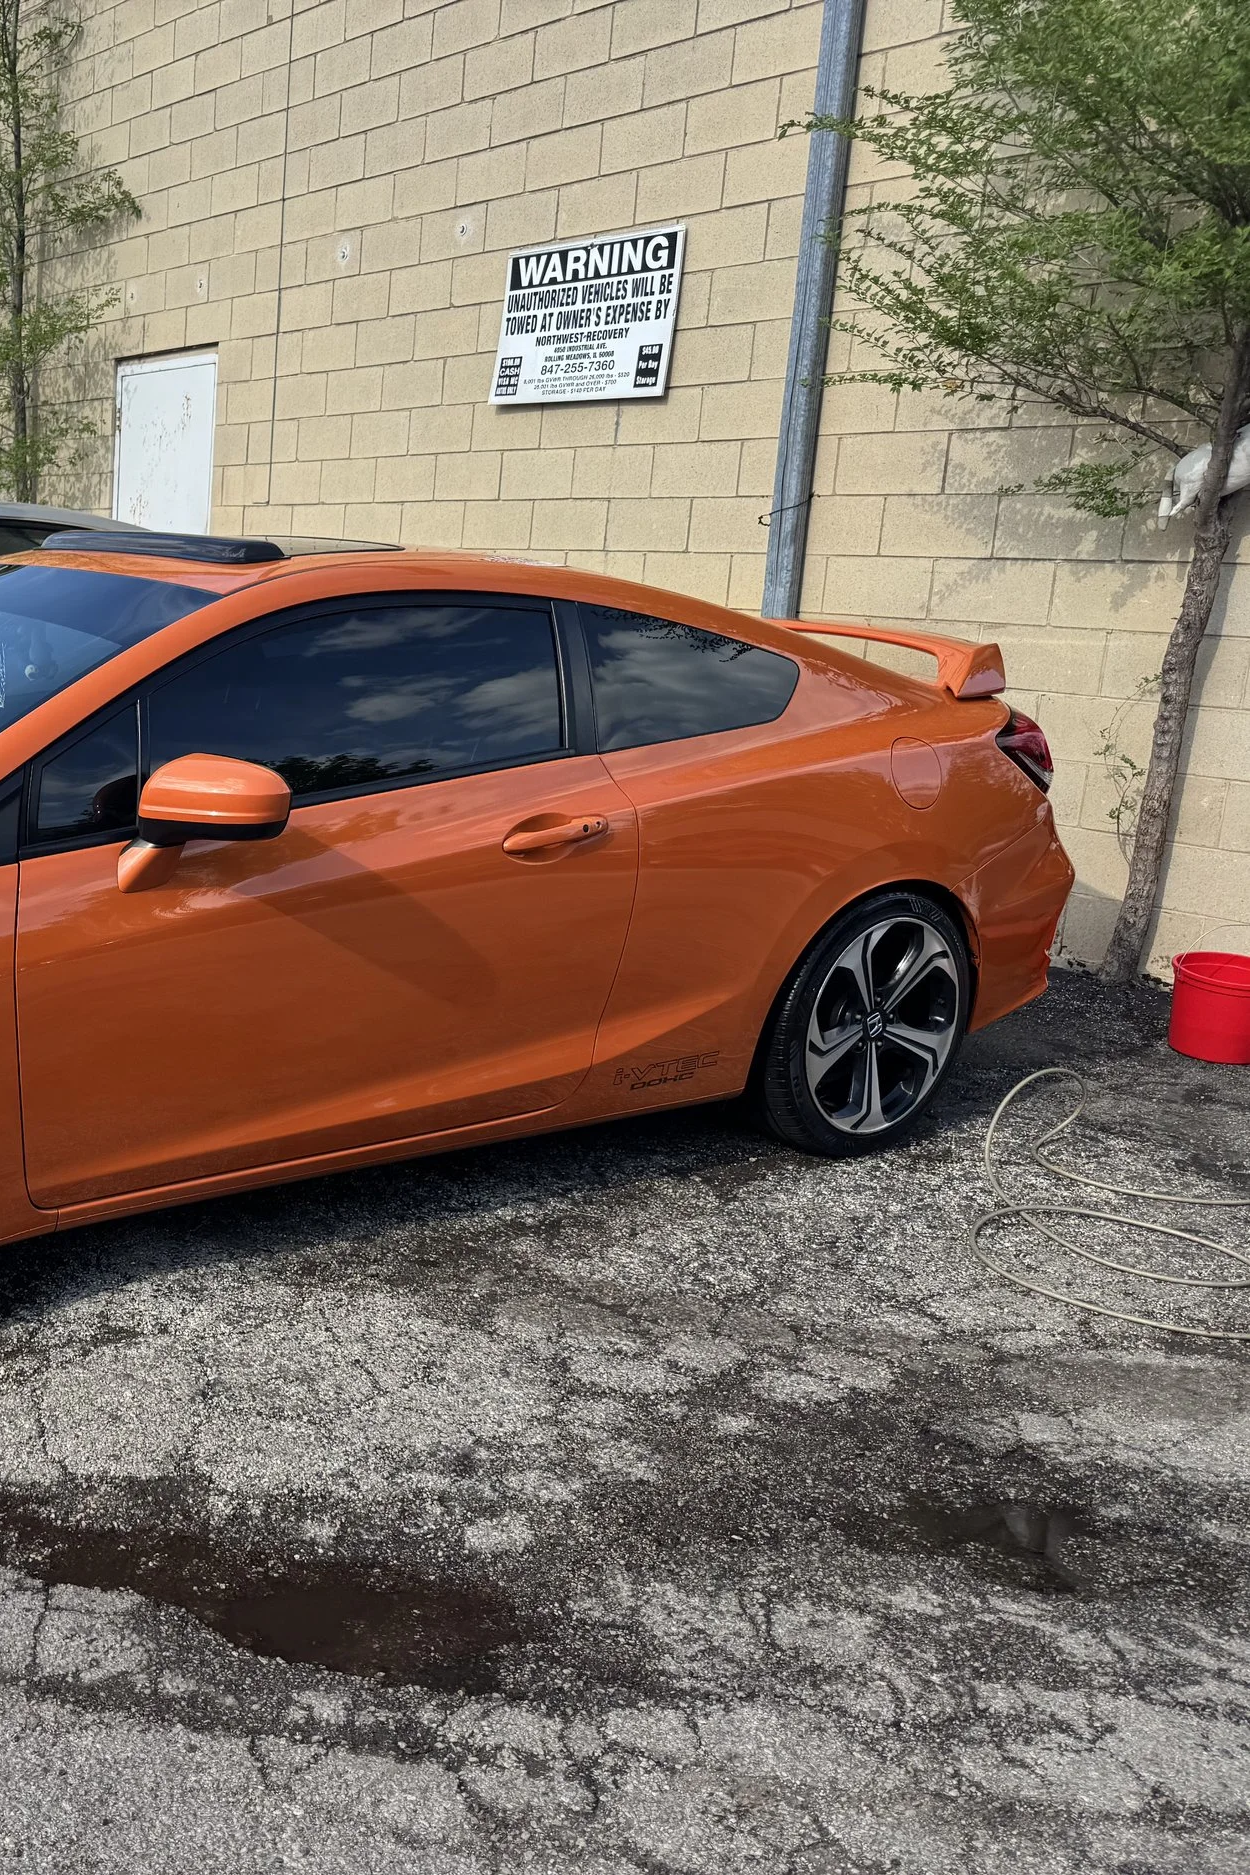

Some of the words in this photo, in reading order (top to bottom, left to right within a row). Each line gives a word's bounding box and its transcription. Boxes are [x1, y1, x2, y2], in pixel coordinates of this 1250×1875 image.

[519, 236, 669, 287] WARNING
[507, 286, 578, 314] UNAUTHORIZED
[582, 279, 628, 305] VEHICLES
[632, 275, 655, 298] WILL
[659, 273, 674, 295] BE
[505, 313, 538, 336] TOWED
[540, 311, 554, 333] AT
[556, 307, 601, 331] OWNER'S
[605, 301, 651, 326] EXPENSE
[654, 298, 671, 320] BY
[567, 343, 594, 352] INDUSTRIAL
[596, 342, 607, 350] AVE.
[565, 352, 591, 361] MEADOWS,
[540, 359, 615, 375] 847-255-7360
[638, 360, 648, 369] Per
[500, 367, 520, 376] CASH
[636, 376, 656, 385] Storage
[630, 1071, 695, 1091] DOHC
